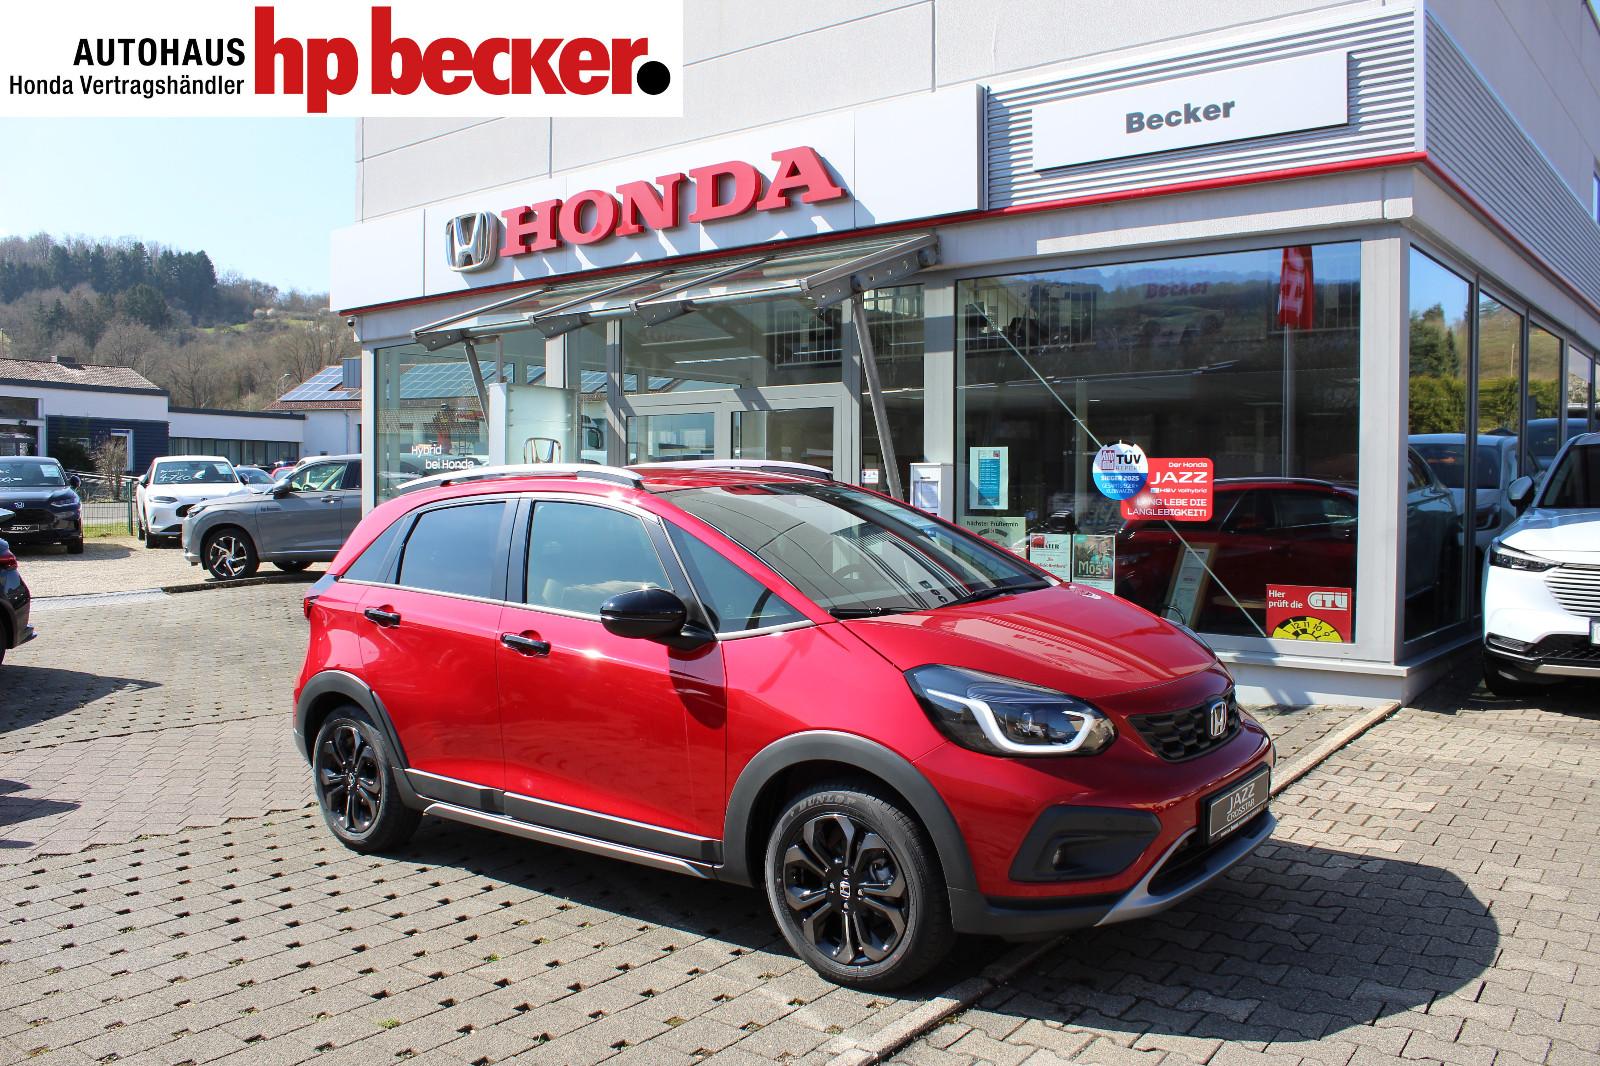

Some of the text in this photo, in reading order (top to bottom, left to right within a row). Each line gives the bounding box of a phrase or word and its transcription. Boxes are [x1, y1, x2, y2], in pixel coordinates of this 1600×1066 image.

[1126, 100, 1235, 134] Becker
[500, 145, 848, 257] HONDA
[411, 444, 442, 458] Hybrid
[425, 458, 475, 470] bei Honda
[1150, 471, 1208, 484] JAZZ
[1164, 498, 1188, 506] LEBE
[1190, 498, 1208, 506] DIE
[1268, 589, 1286, 598] Hier
[1268, 599, 1303, 609] prüft die
[1291, 622, 1302, 630] 12
[1313, 623, 1322, 632] 10
[1226, 782, 1256, 815] JAZZ
[1226, 798, 1256, 823] CROSSTAR
